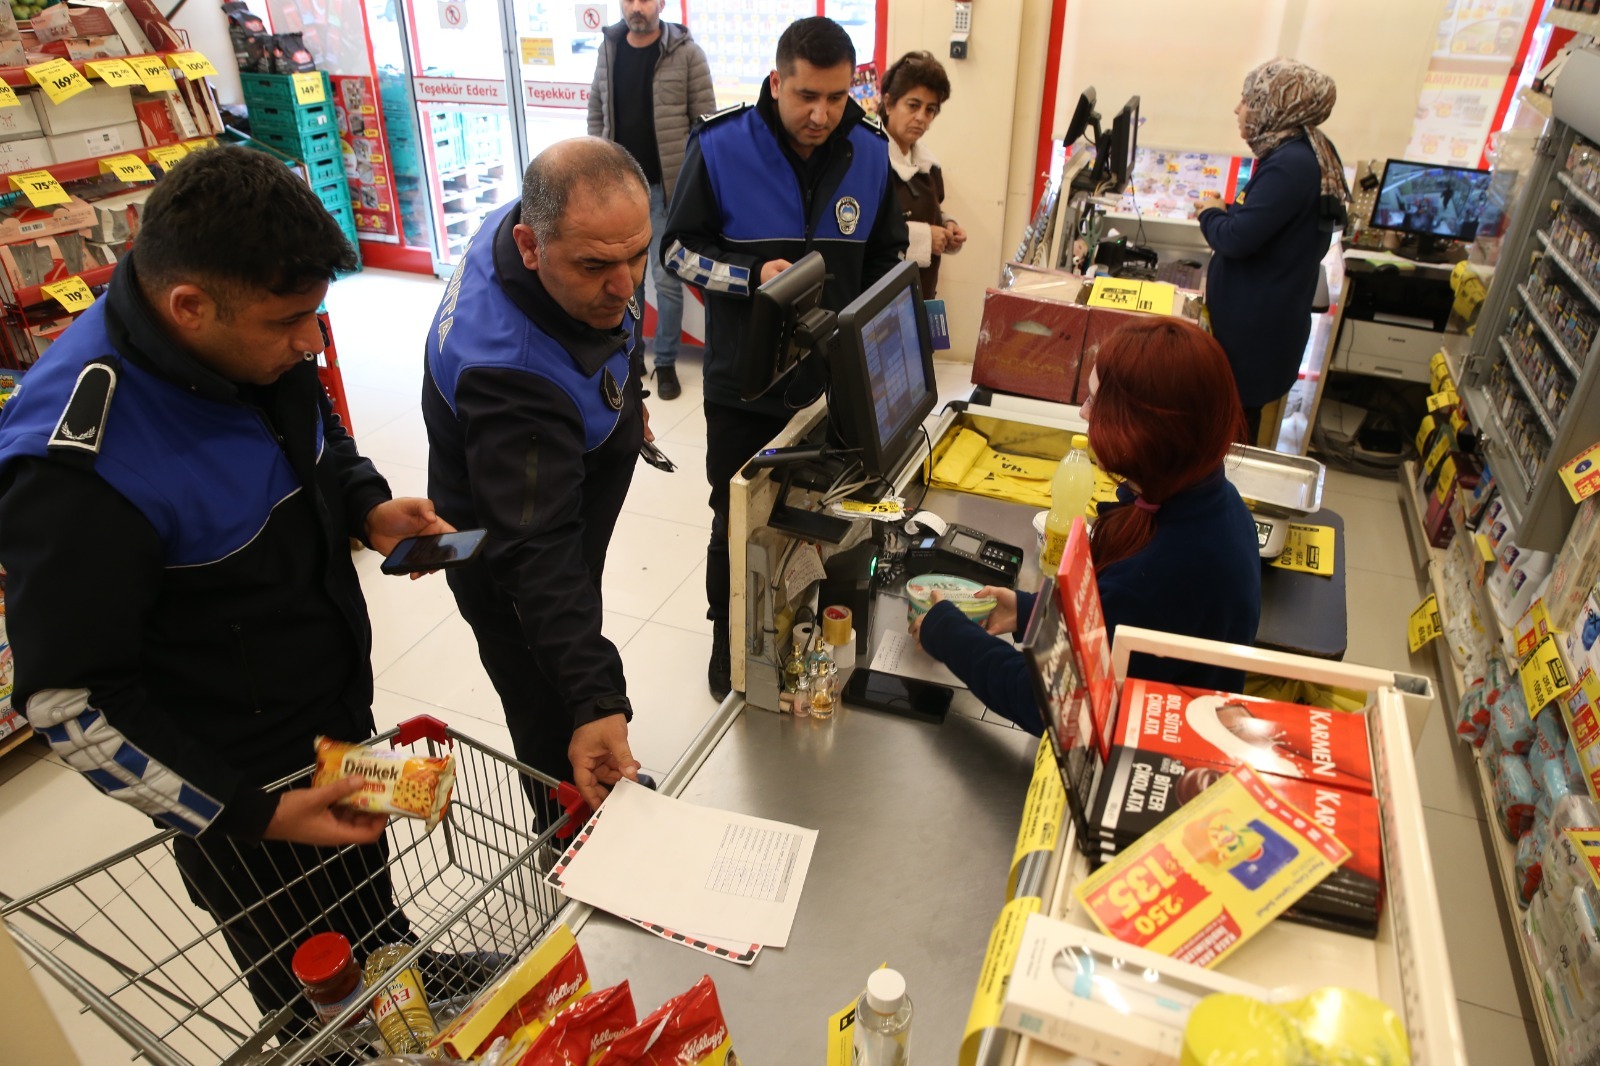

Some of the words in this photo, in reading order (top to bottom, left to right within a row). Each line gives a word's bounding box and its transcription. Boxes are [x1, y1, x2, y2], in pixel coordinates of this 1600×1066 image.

[419, 83, 462, 96] Teşekkür
[467, 85, 498, 97] Ederiz
[528, 87, 576, 101] Teşekkür
[1144, 694, 1162, 735] ÇİKOLATA
[1167, 694, 1182, 710] BOL
[1162, 712, 1182, 743] SÜTLÜ
[1309, 710, 1336, 777] KARMEN
[1125, 763, 1152, 813] ÇİKOLATA
[1148, 774, 1171, 812] BİTTER
[379, 988, 410, 1017] Evin
[547, 973, 583, 1007] Kellogg's
[686, 1026, 726, 1058] Kellogg's
